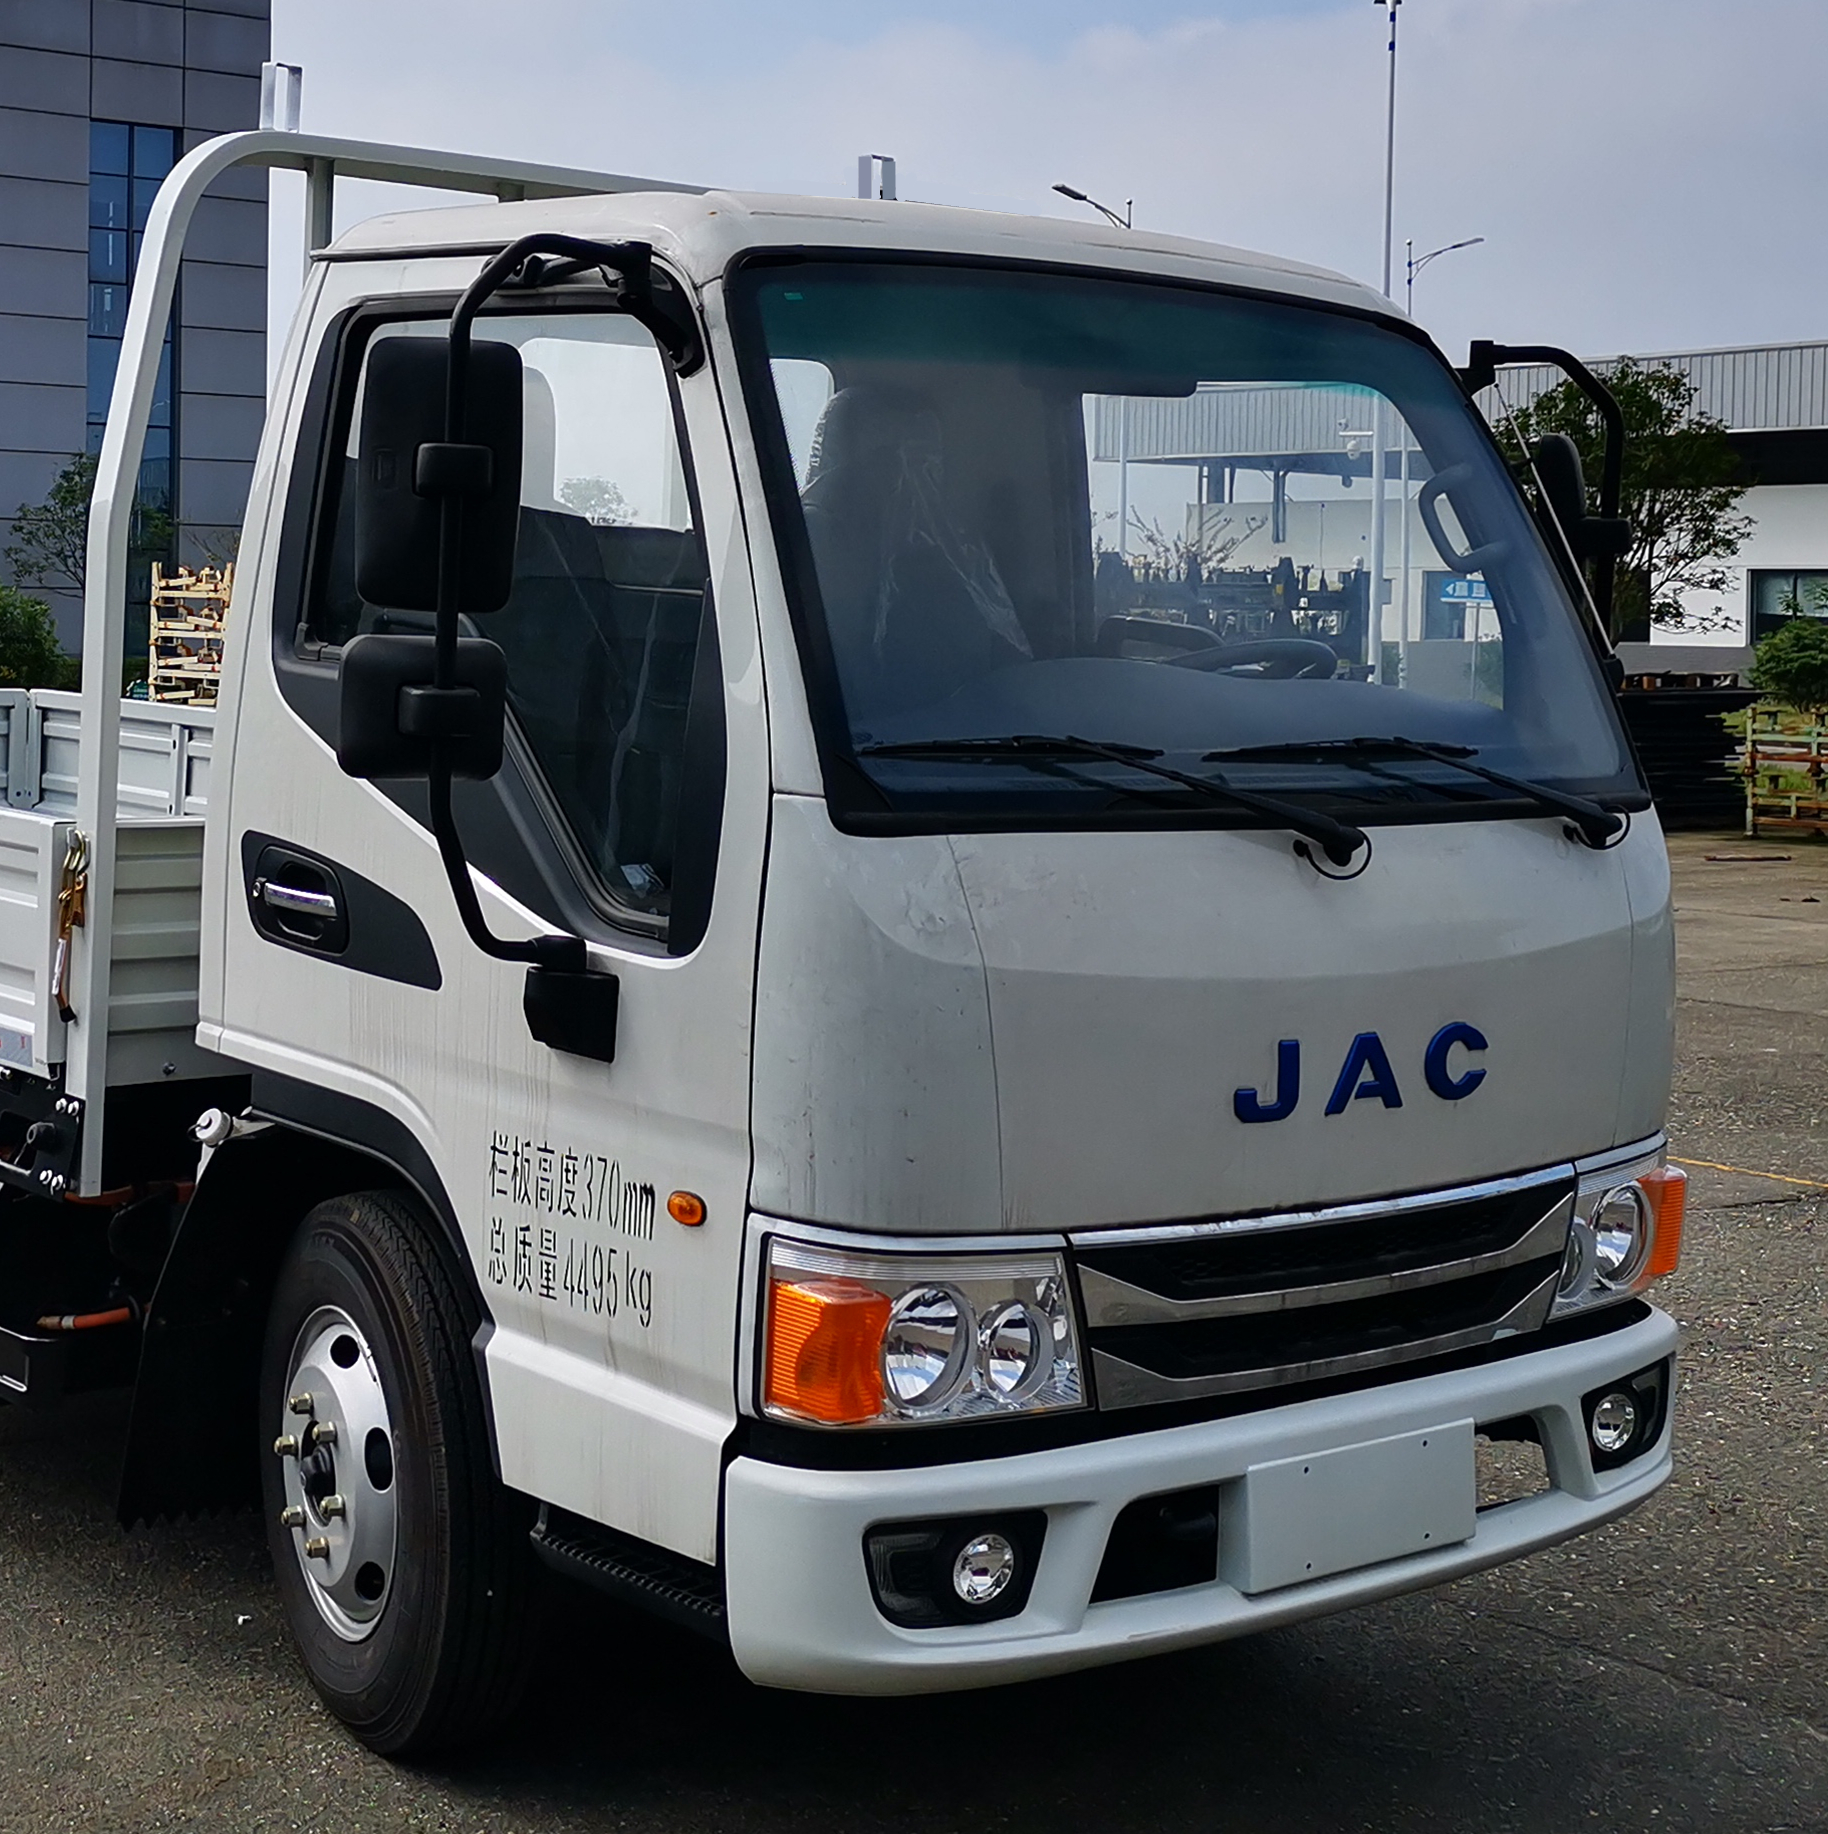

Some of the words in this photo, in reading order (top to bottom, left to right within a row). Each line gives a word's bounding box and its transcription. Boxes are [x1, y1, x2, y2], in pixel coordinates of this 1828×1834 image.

[1233, 1021, 1489, 1124] JAC
[488, 1130, 656, 1241] 栏板高度370mm
